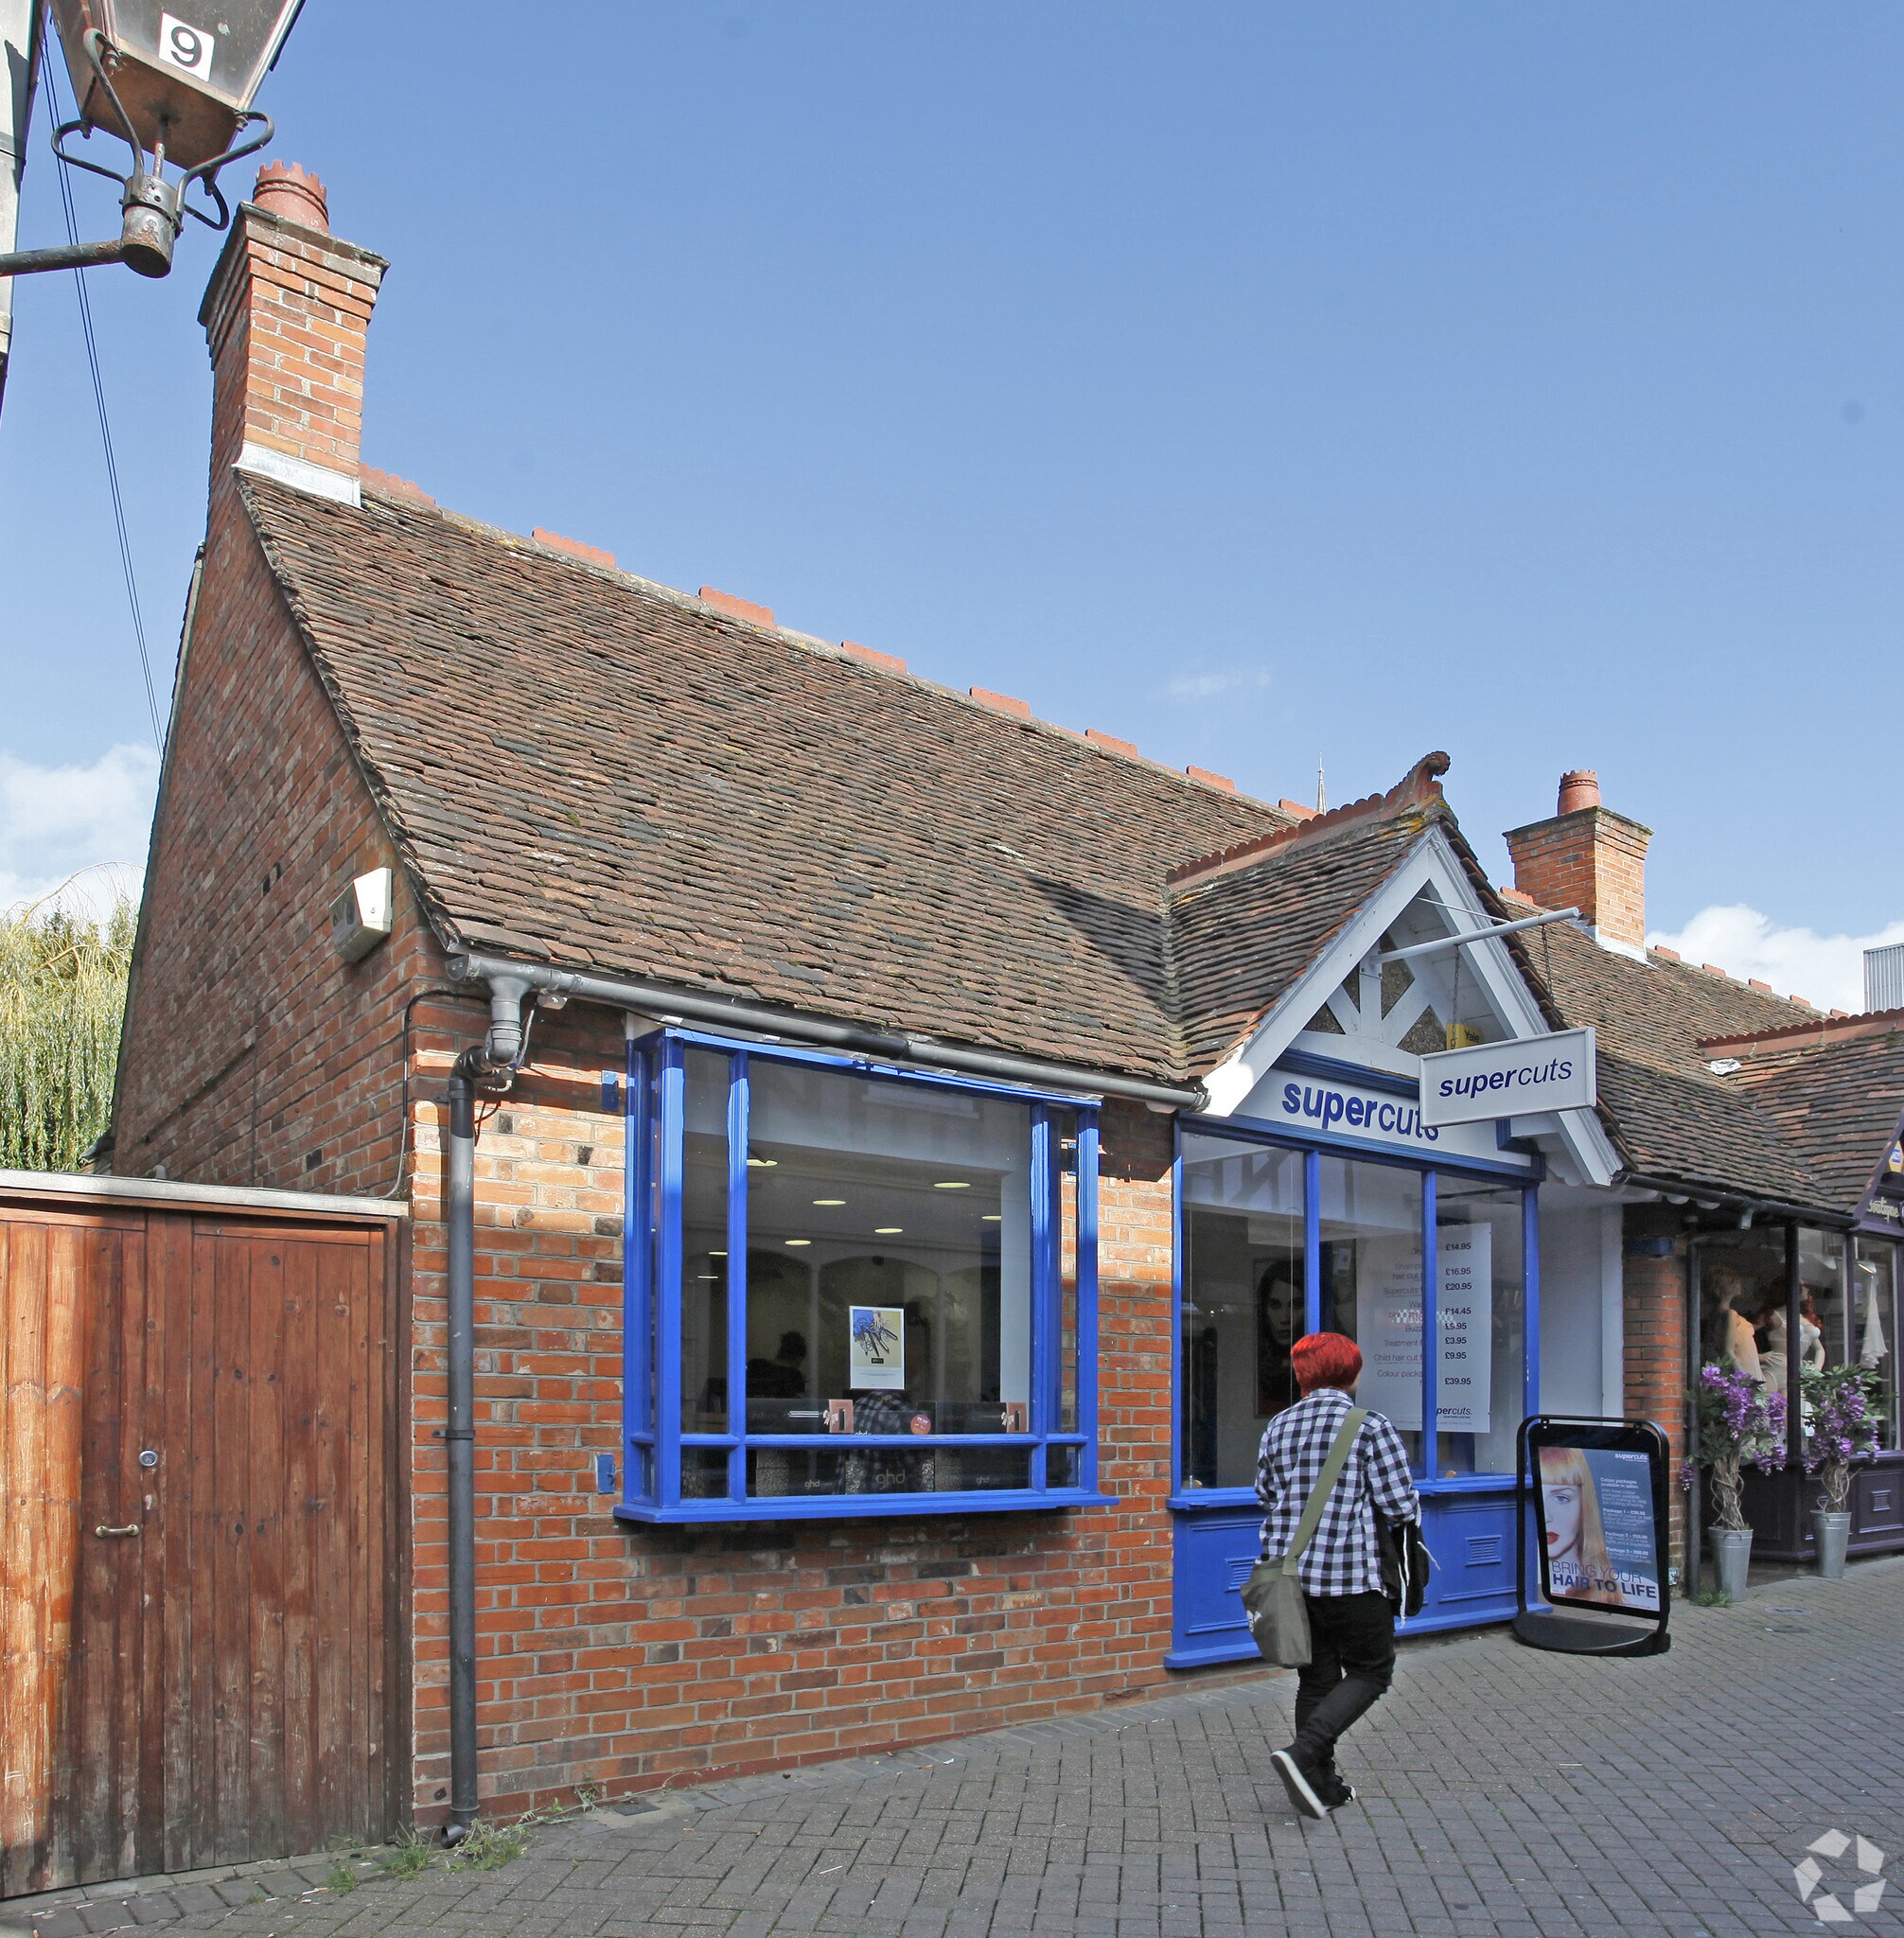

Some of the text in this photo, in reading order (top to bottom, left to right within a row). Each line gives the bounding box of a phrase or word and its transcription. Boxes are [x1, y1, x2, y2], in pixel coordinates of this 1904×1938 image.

[171, 26, 203, 68] 9
[1464, 1029, 1480, 1043] Yale
[1438, 1058, 1573, 1099] supercuts
[1445, 1242, 1472, 1251] £14.95
[1445, 1267, 1472, 1276] £16.95
[1445, 1282, 1472, 1291] £20.95
[804, 1479, 820, 1489] ghd
[875, 1469, 906, 1489] ghd
[1552, 1560, 1642, 1583] BRING YOUR
[1553, 1573, 1657, 1599] HAIR TO LIFE
